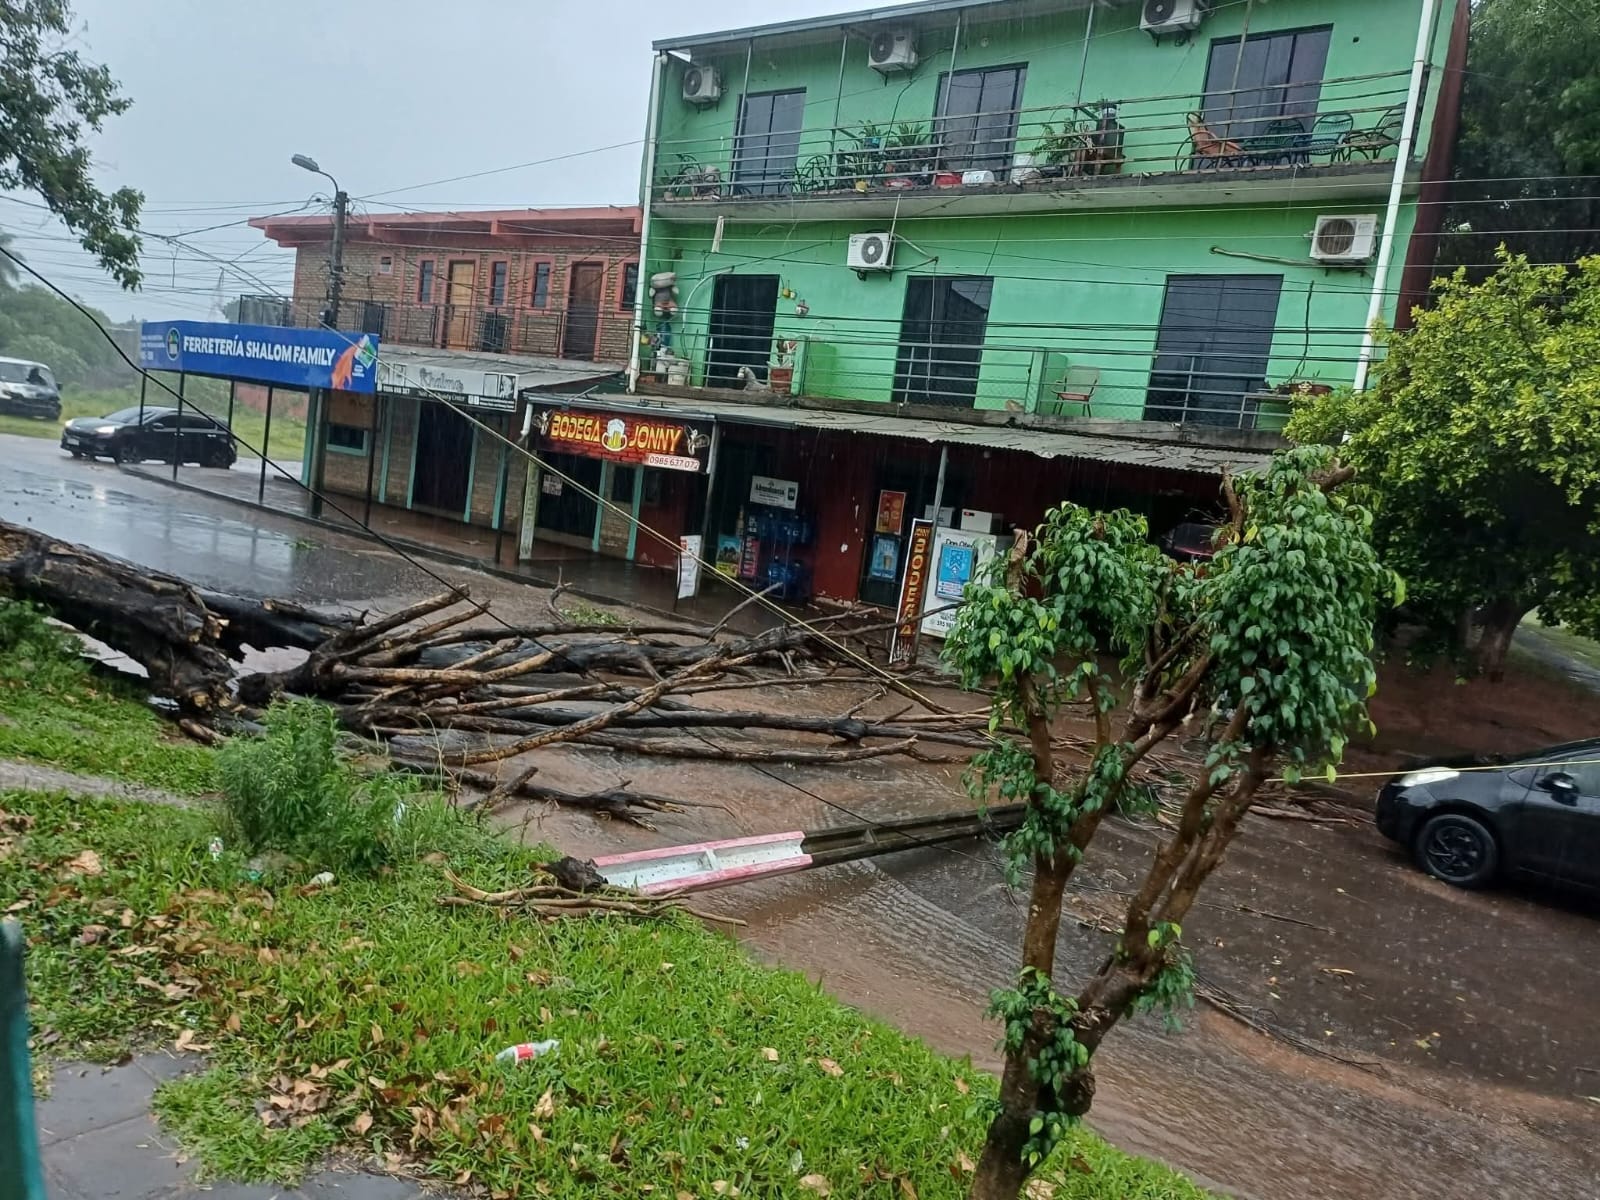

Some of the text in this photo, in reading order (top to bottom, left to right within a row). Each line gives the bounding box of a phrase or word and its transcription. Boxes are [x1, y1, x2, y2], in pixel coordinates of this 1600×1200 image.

[183, 334, 244, 357] FERRETERÍA
[246, 342, 293, 363] SHALOM
[293, 345, 337, 367] FAMILY
[551, 414, 682, 453] BODEGA JONNY
